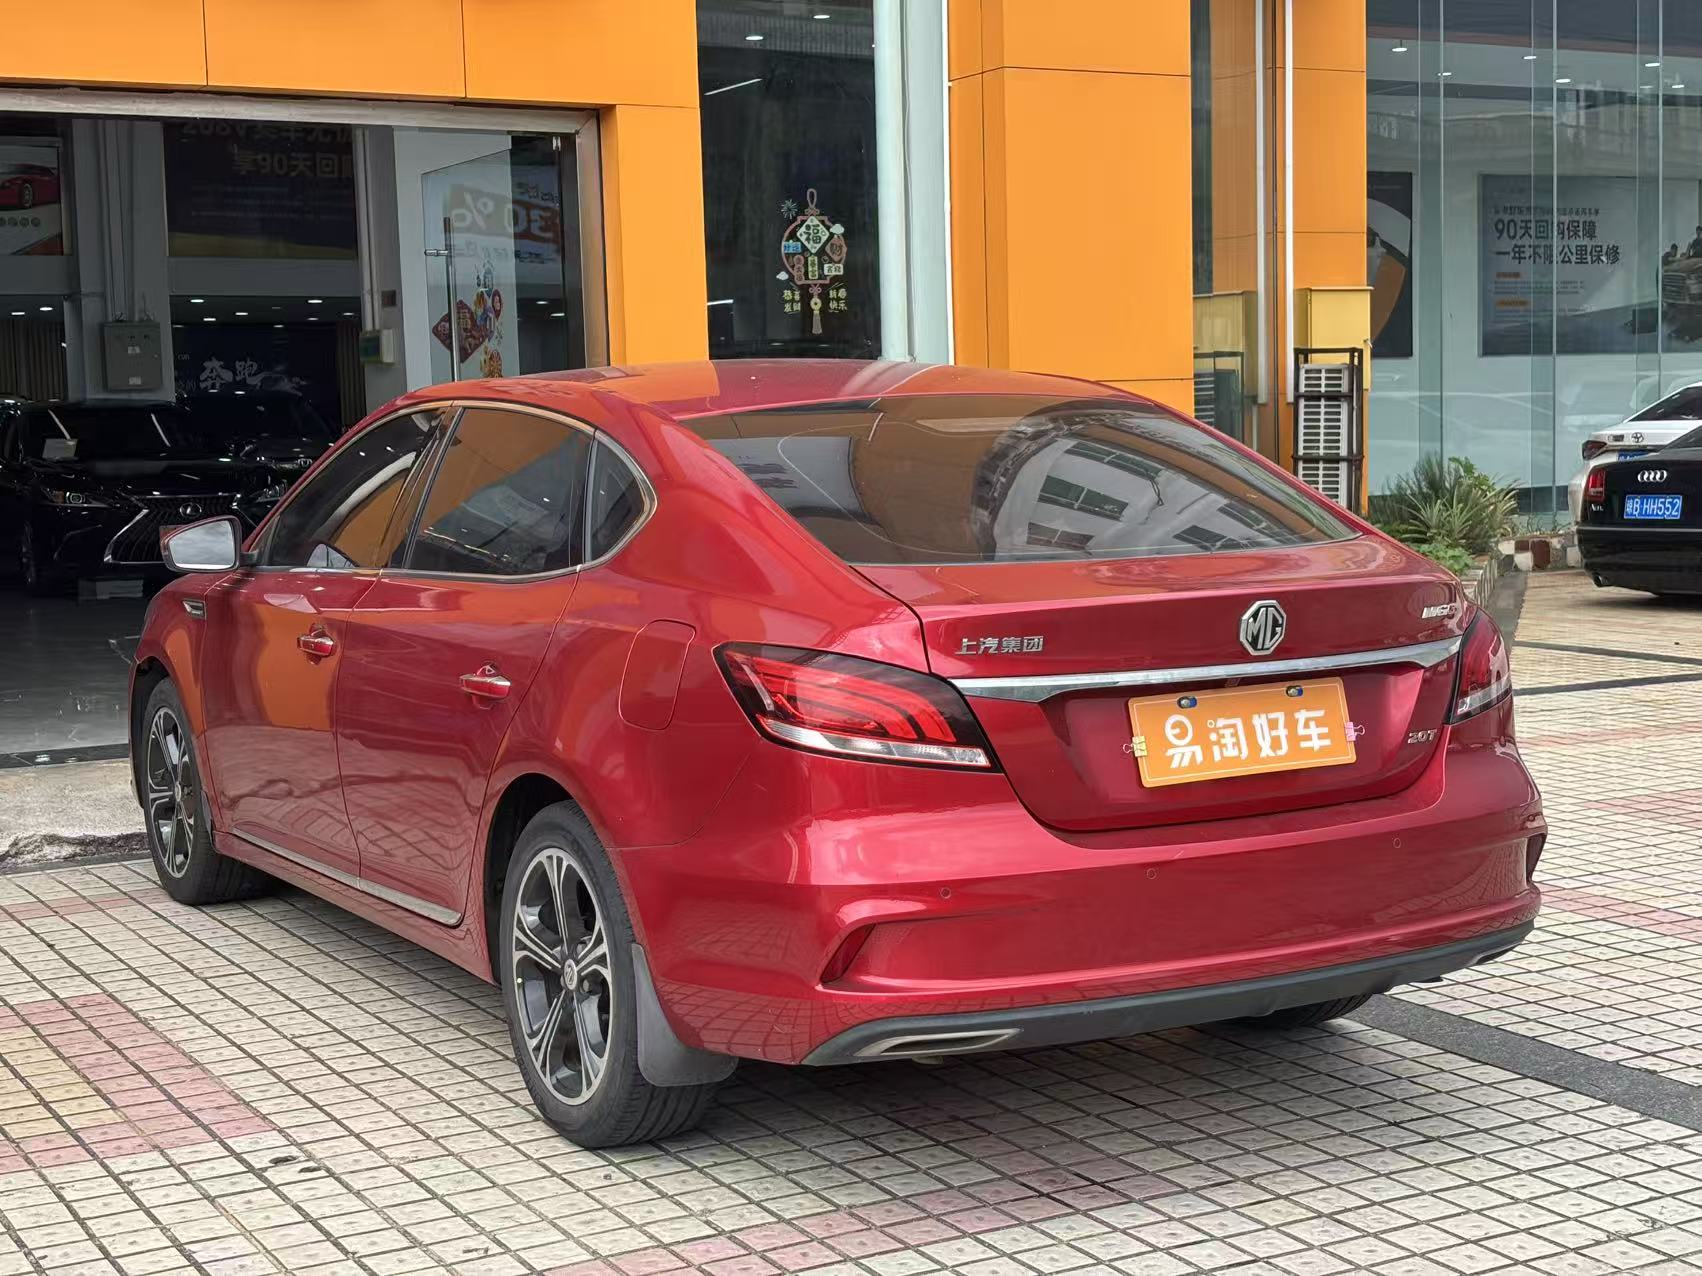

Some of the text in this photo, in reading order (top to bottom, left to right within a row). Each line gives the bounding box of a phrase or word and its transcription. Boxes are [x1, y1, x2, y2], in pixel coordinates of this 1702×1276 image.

[803, 224, 822, 245] 福
[954, 635, 1044, 655] 上汽集团
[1245, 606, 1284, 651] MG
[1164, 709, 1332, 769] 易淘好车
